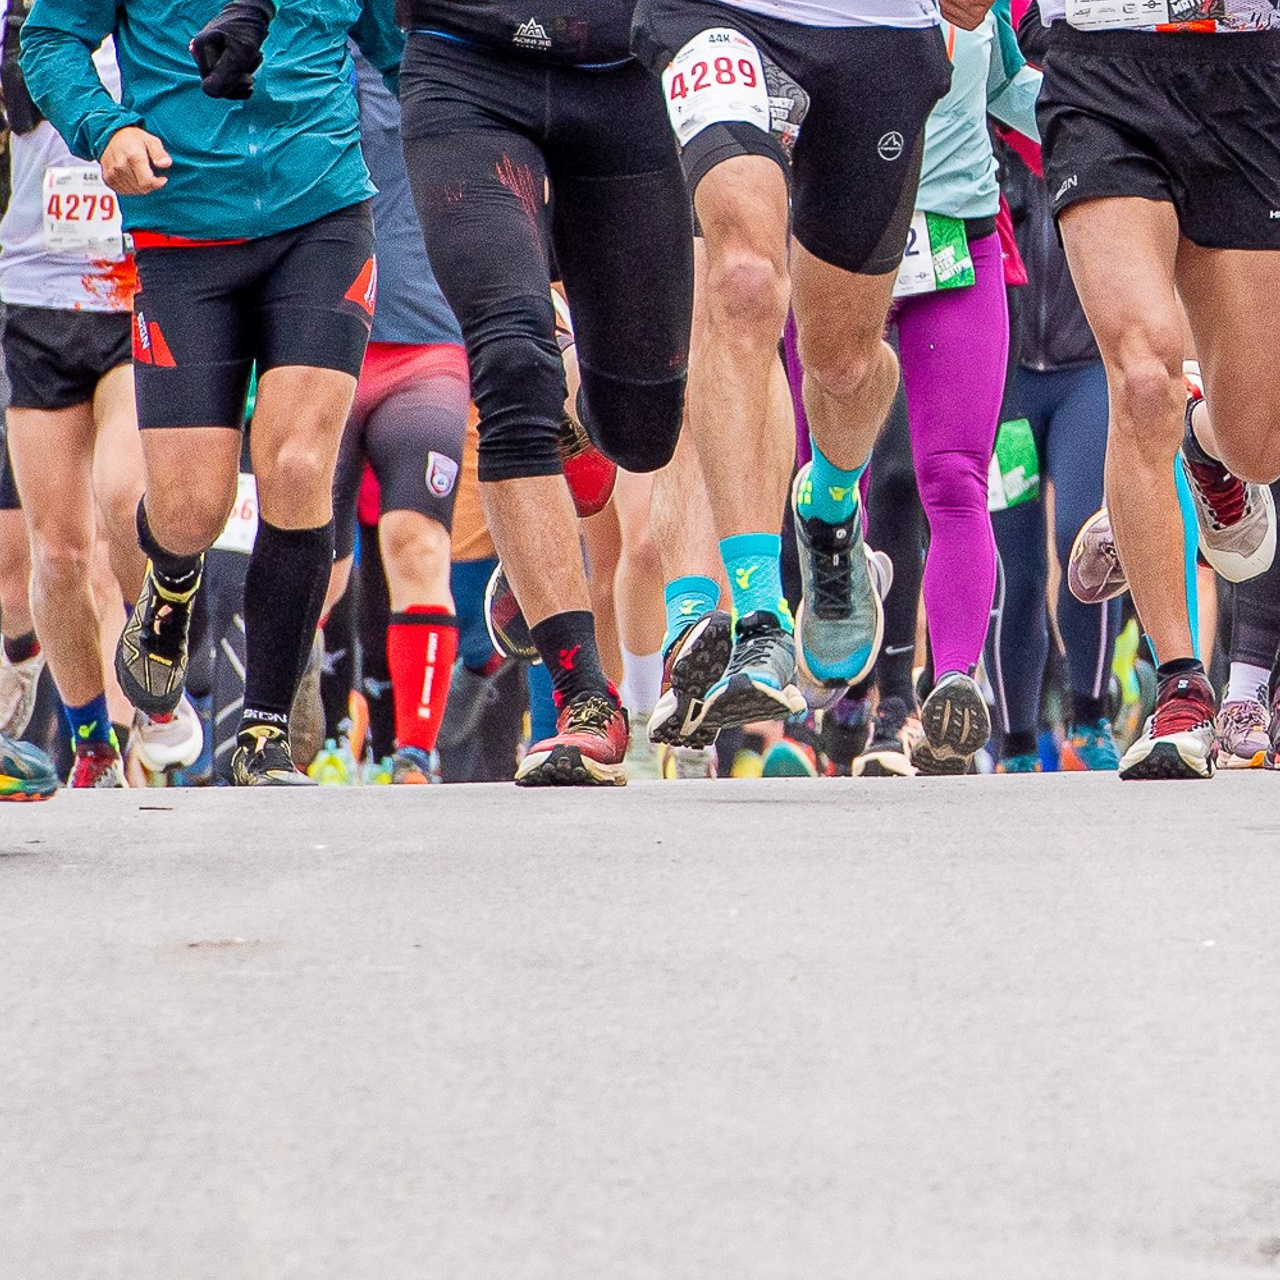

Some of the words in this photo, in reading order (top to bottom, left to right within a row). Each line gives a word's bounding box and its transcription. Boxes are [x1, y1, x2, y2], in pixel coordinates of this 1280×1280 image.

[708, 34, 731, 43] 44K
[670, 57, 758, 101] 4289
[47, 194, 115, 222] 4279
